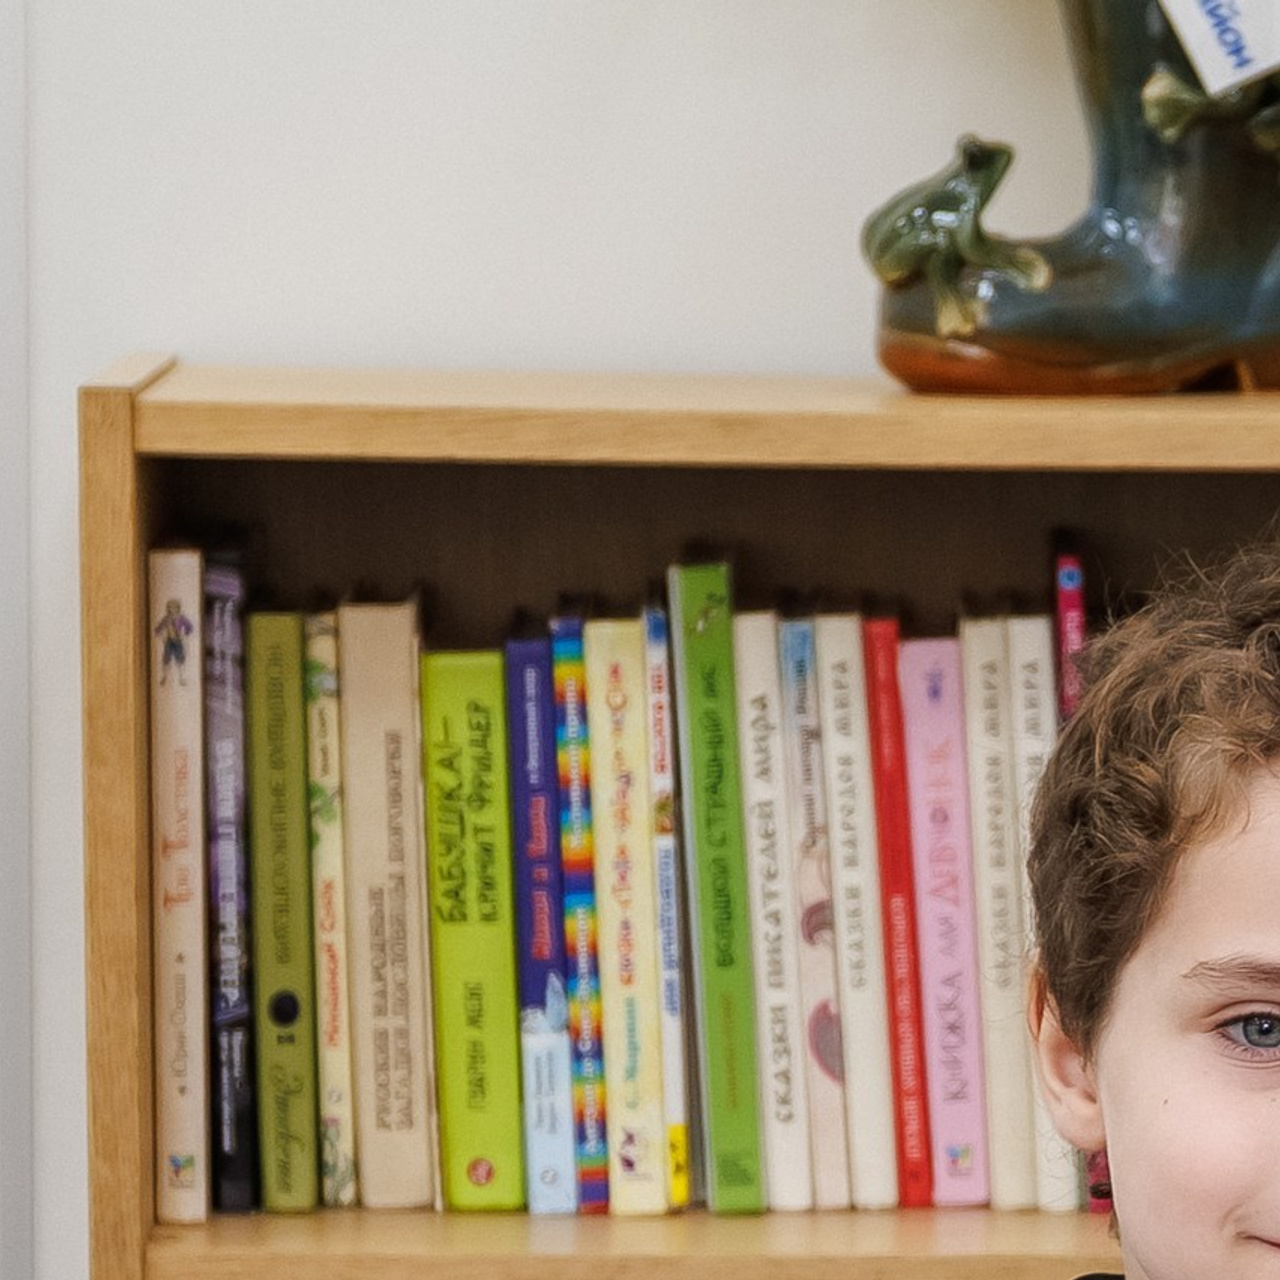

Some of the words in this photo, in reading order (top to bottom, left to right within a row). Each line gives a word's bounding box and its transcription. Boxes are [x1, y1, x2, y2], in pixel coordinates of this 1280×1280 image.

[751, 693, 778, 783] МИРА
[832, 660, 853, 738] МИРА
[977, 660, 1003, 738] МИРА
[1019, 659, 1043, 738] МИРА
[838, 754, 860, 868] НАРОДОВ
[983, 754, 1007, 868] НАРОДОВ
[755, 799, 785, 990] ПИСАТЕЛЕЙ
[844, 883, 868, 990] СКАЗКИ
[990, 883, 1012, 990] СКАЗКИ
[769, 1005, 796, 1123] СКАЗКИ
[939, 971, 969, 1104] КНИЖКА
